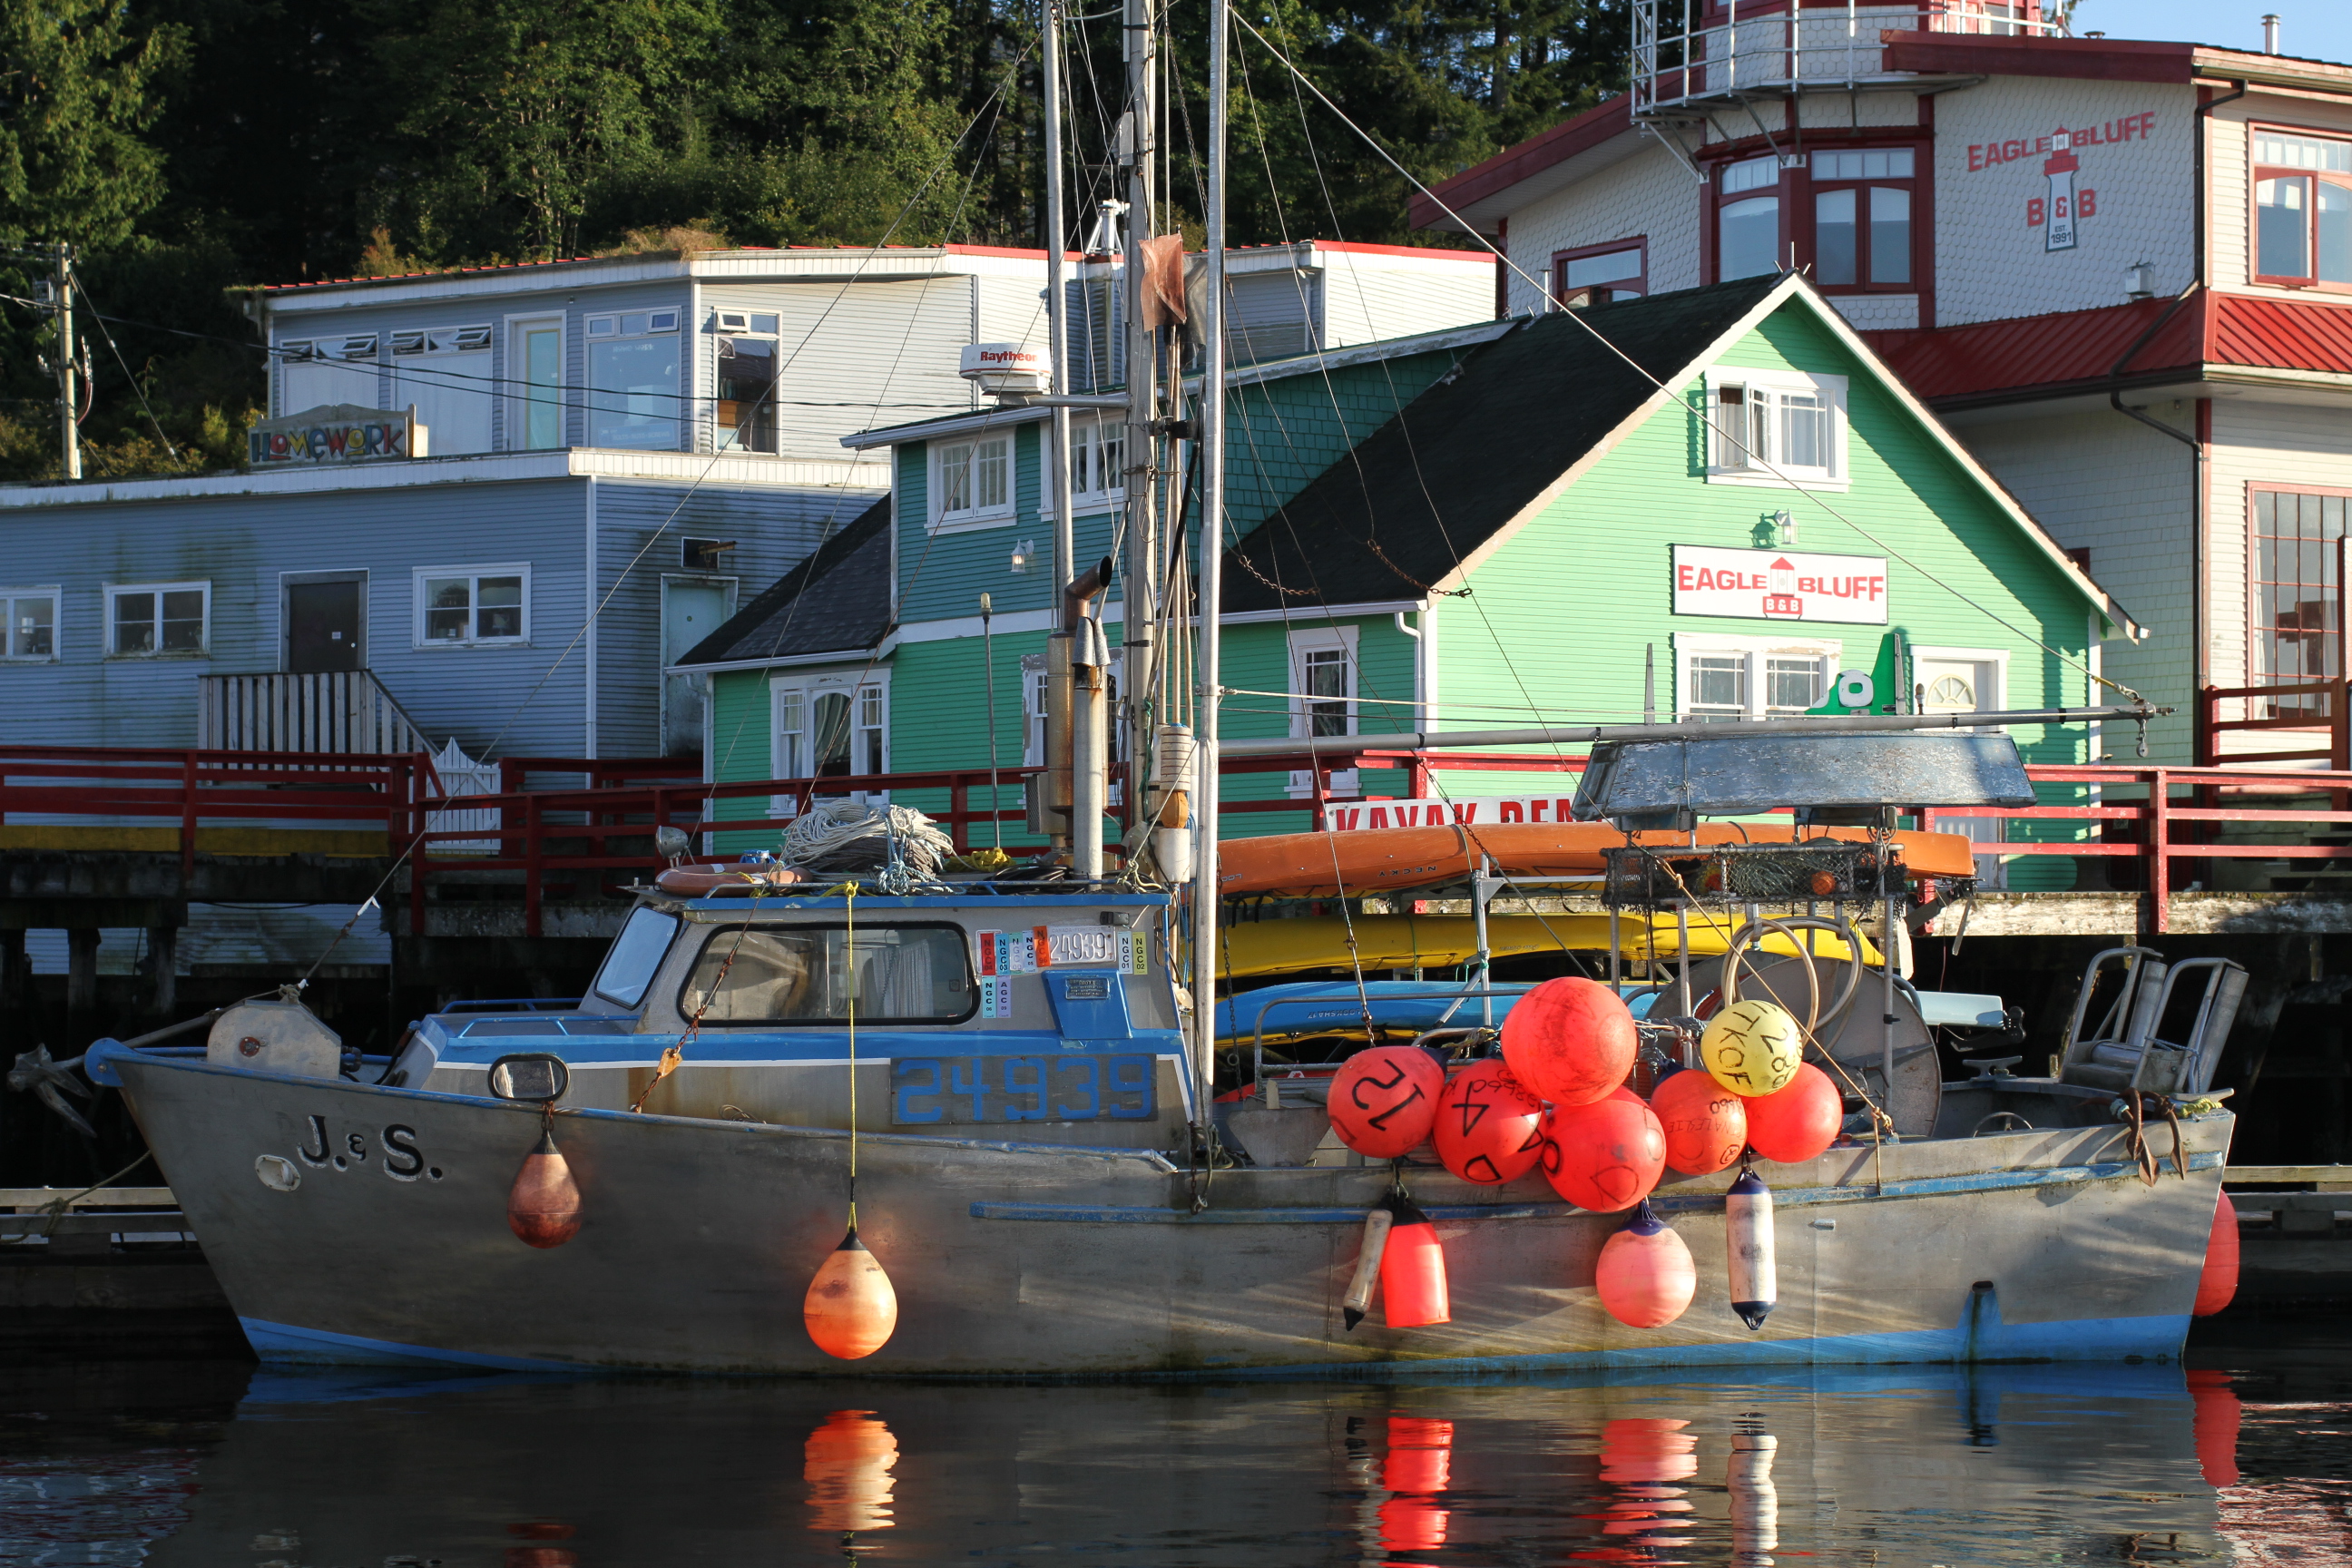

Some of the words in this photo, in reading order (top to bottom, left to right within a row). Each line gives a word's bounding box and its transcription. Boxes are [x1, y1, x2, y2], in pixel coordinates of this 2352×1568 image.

[1968, 136, 2050, 172] EAGLE
[2072, 111, 2155, 146] BLUFF
[2027, 198, 2045, 227] B
[2055, 196, 2068, 218] &
[2078, 188, 2097, 218] B
[2051, 231, 2072, 243] 1991
[980, 351, 1038, 363] Raytheon
[250, 424, 403, 463] HOMEWORK
[1678, 564, 1768, 592] EAGLE
[1798, 575, 1884, 602] BLUFF
[1377, 865, 1436, 877] NECKY
[1050, 932, 1108, 962] 24939
[897, 1055, 1152, 1122] 24939
[297, 1114, 348, 1172] J.
[380, 1123, 444, 1182] S.
